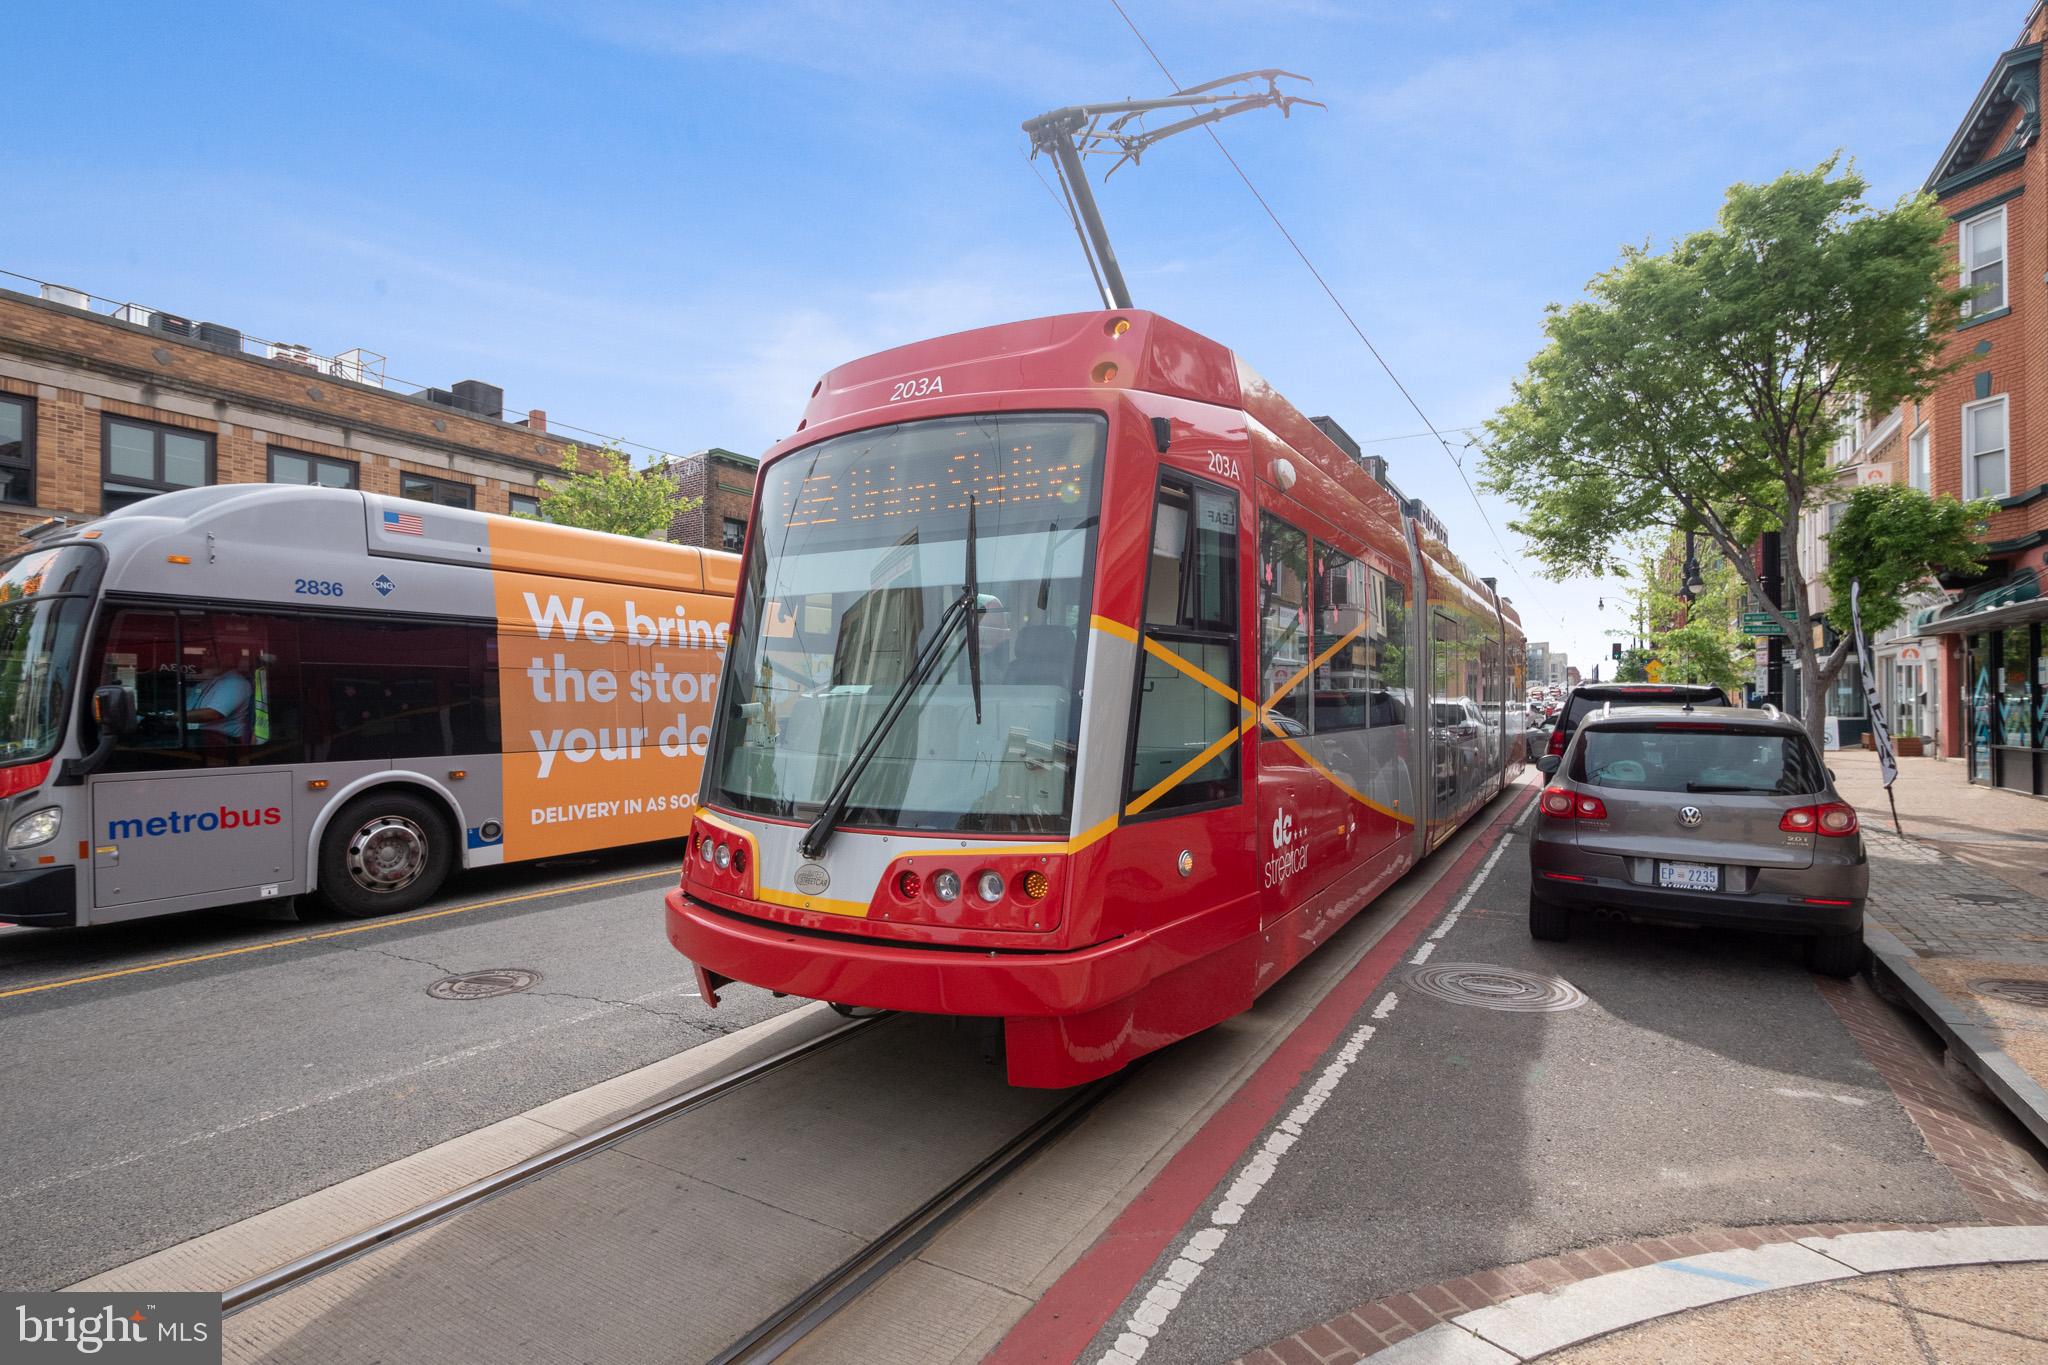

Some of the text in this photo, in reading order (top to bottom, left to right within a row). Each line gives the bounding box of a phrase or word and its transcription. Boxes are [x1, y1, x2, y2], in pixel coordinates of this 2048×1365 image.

[890, 375, 943, 402] 203A
[1207, 449, 1240, 481] 203A
[294, 578, 344, 597] 2836
[373, 579, 395, 591] CNG
[522, 591, 616, 645] We
[527, 653, 721, 703] the stor
[529, 726, 649, 779] your
[108, 806, 282, 840] metrobus
[531, 800, 620, 826] DELIVERY
[624, 798, 643, 815] IN
[646, 796, 667, 813] AS
[1272, 807, 1293, 849] dc
[1264, 843, 1310, 889] streetcar
[1661, 868, 1716, 884] EP 2235
